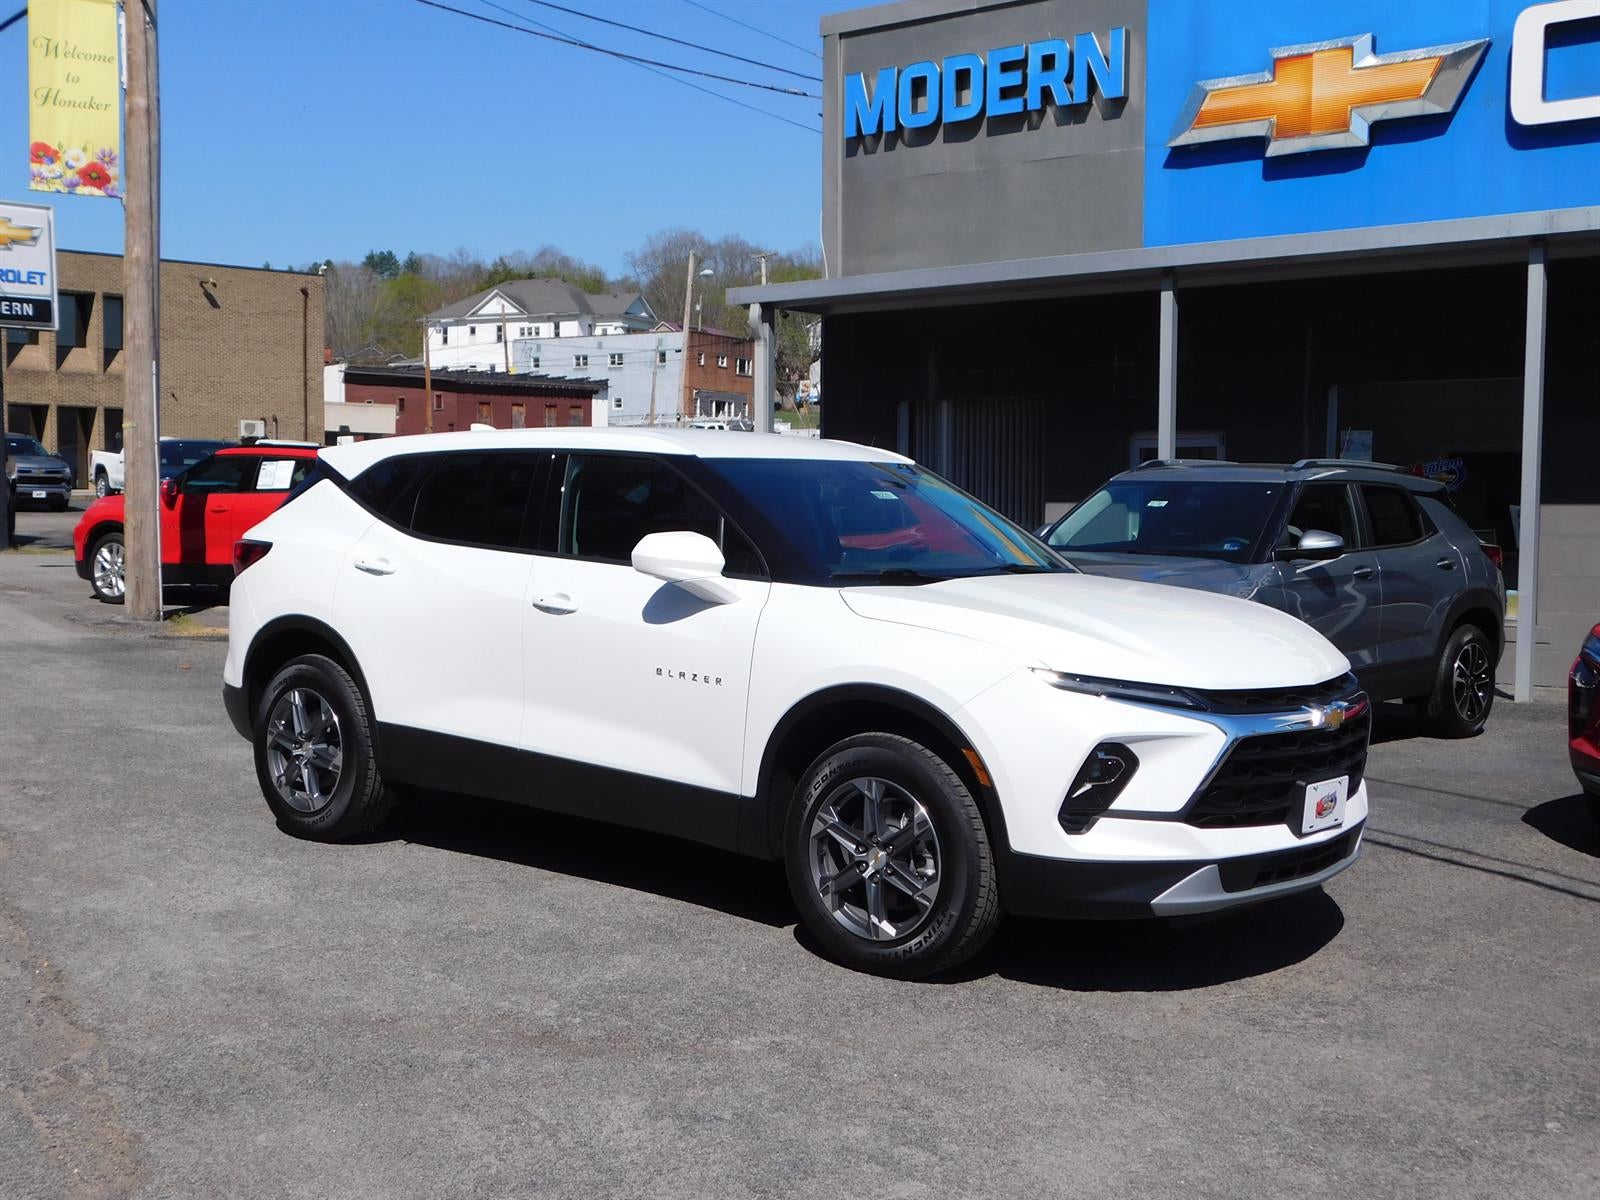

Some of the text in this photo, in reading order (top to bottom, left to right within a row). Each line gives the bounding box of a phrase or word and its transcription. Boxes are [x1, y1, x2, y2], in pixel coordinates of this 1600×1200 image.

[32, 35, 115, 63] Welcome
[65, 72, 80, 84] to
[844, 26, 1126, 138] MODERN
[34, 86, 111, 111] Honaker
[656, 667, 722, 686] BLAZER
